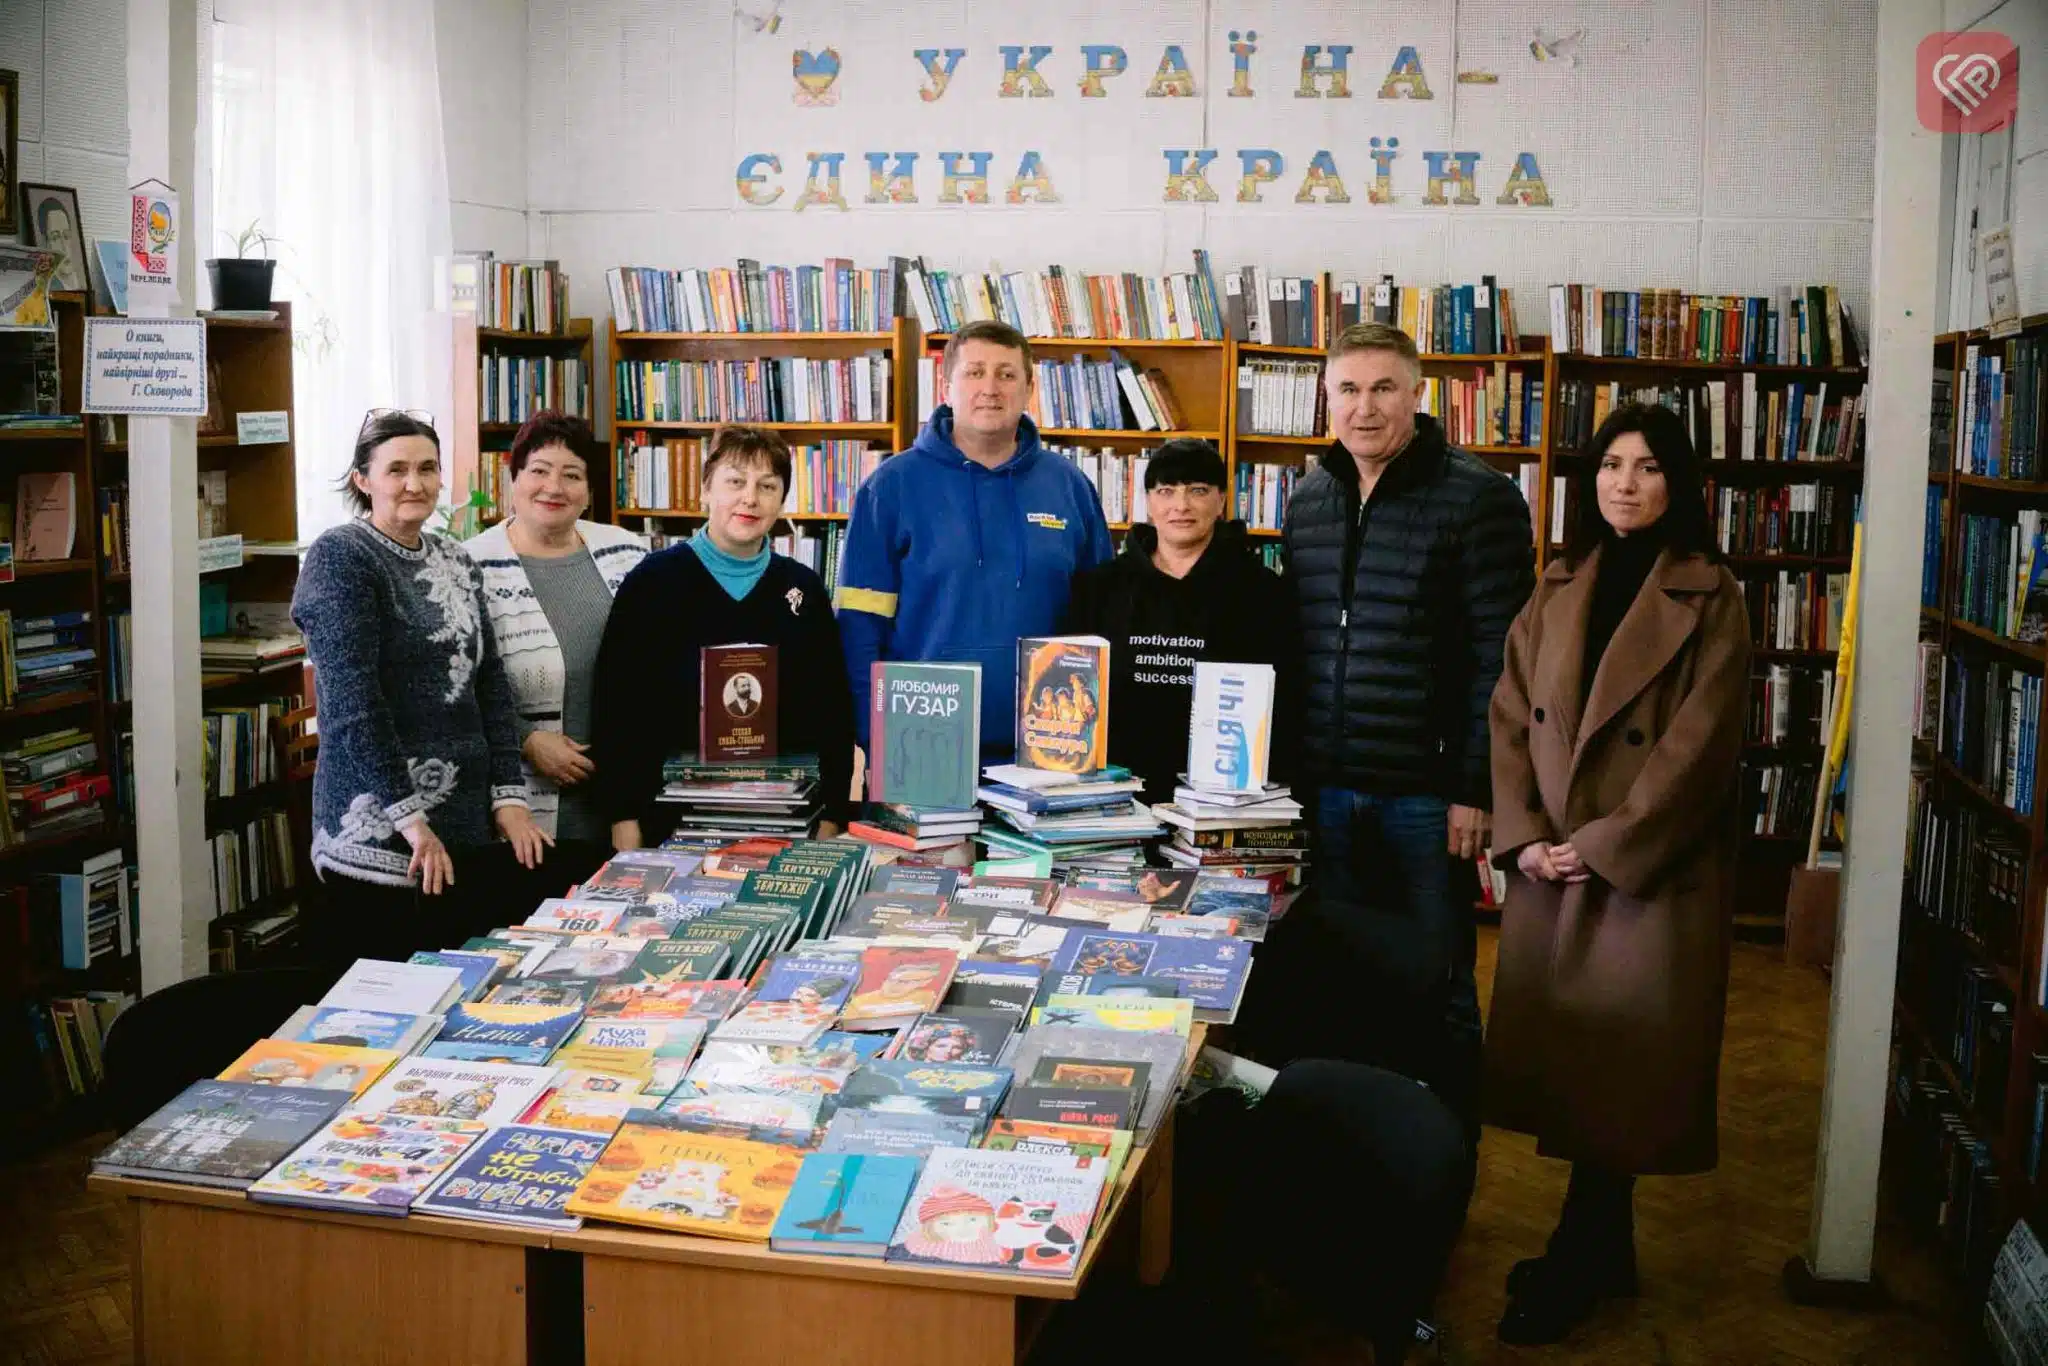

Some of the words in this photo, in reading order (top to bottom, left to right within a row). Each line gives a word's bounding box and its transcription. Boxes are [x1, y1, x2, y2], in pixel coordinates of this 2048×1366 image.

[735, 151, 1062, 213] ЄДИНА
[1162, 136, 1553, 207] КРАЇНА
[126, 329, 134, 342] О
[136, 333, 165, 344] книги,
[97, 348, 141, 362] найкращі
[142, 348, 195, 362] порадники,
[103, 365, 153, 381] найвірніші
[143, 383, 193, 399] Сковорода
[1128, 634, 1205, 648] motivation
[1135, 653, 1195, 667] ambition
[891, 680, 960, 695] ЛЮБОМИР
[892, 694, 959, 717] ГУЗАР
